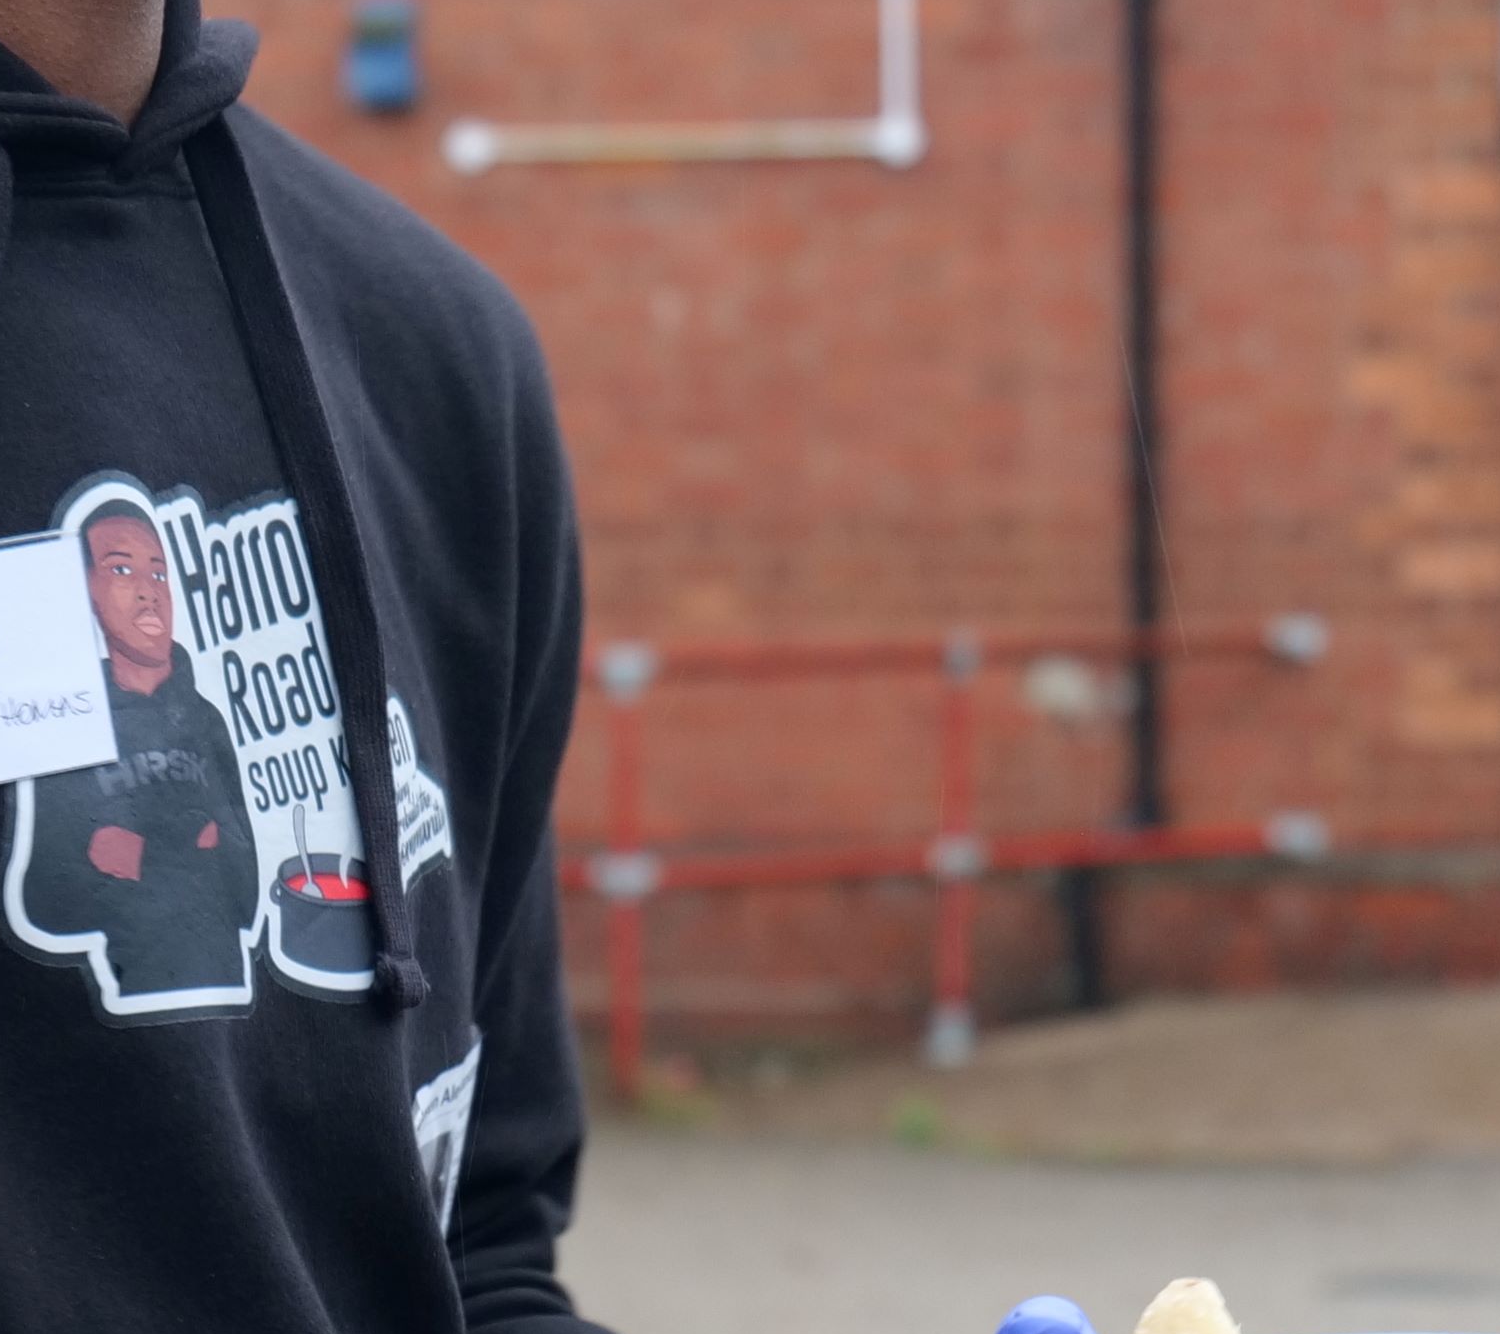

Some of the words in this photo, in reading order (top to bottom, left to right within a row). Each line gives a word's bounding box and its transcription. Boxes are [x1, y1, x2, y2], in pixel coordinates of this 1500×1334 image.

[163, 513, 311, 653] Harro
[222, 622, 337, 748] Road
[250, 744, 328, 812] soup
